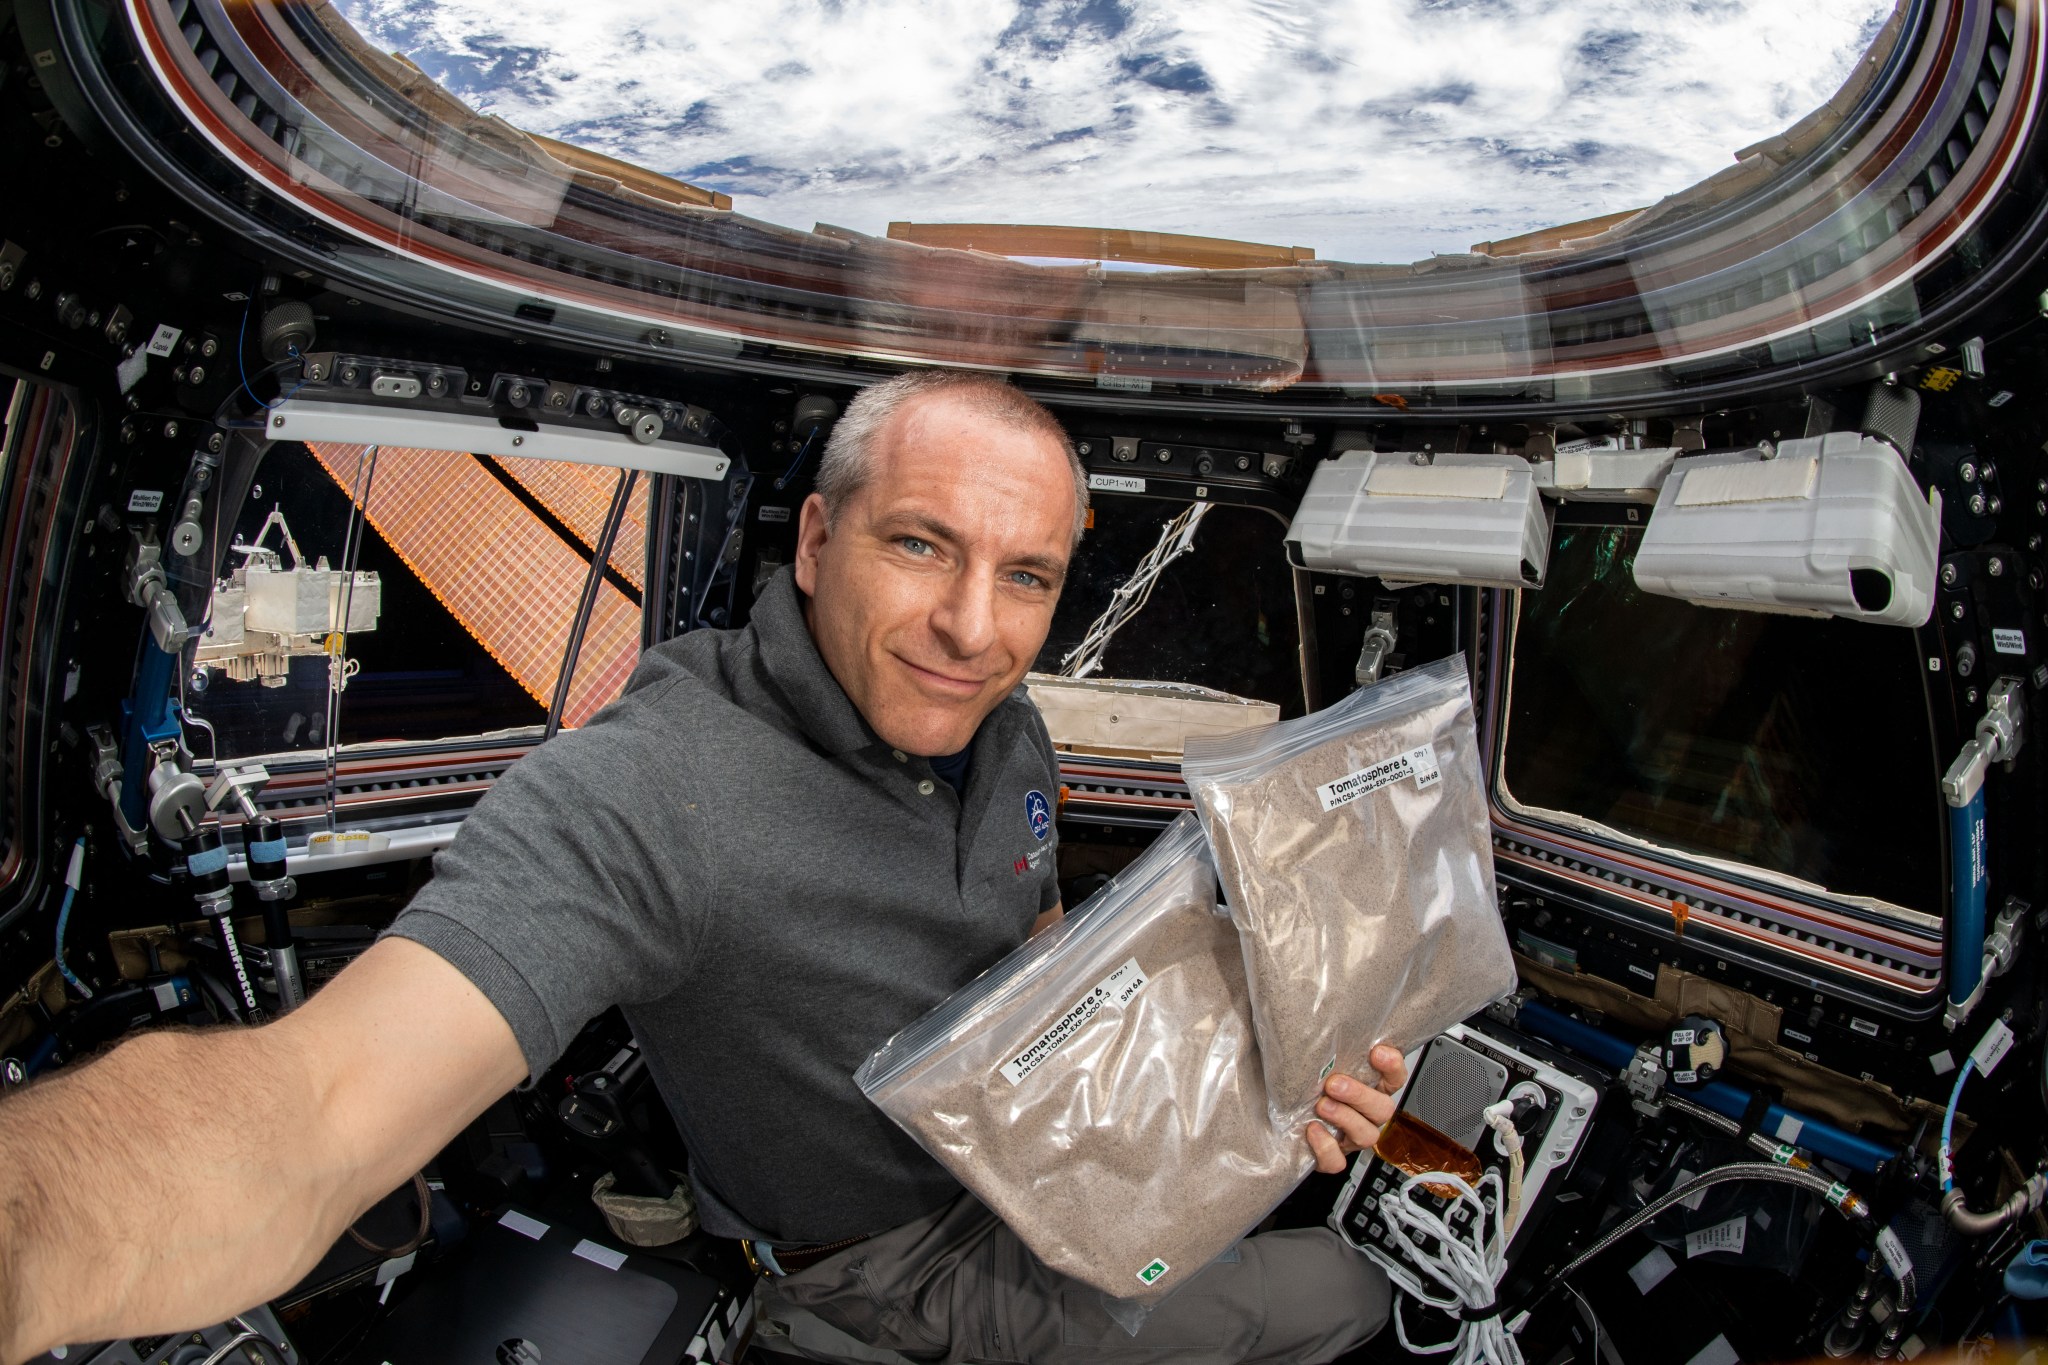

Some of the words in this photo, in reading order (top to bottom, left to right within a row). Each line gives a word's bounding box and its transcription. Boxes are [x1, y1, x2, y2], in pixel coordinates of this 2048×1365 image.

[1095, 477, 1138, 488] CUP1-W1
[1629, 511, 1636, 519] A
[1931, 660, 1937, 669] 3
[1413, 749, 1424, 759] Qty
[1328, 759, 1400, 796] Tomatosphere
[1401, 755, 1408, 767] 6
[1419, 774, 1430, 785] S/N
[1430, 771, 1438, 780] 6B
[1329, 796, 1342, 807] P/N
[314, 834, 333, 843] KEEP
[220, 916, 256, 1008] Manfrotto
[1110, 969, 1123, 981] Qty
[1121, 987, 1134, 1002] S/N
[1132, 978, 1143, 989] 6A
[1013, 995, 1095, 1068] Tomatosphere
[1095, 987, 1103, 996] 6
[1017, 1065, 1031, 1079] P/N
[1030, 991, 1111, 1067] CSA-TOMA-EXP-0001-3
[1466, 1039, 1484, 1052] AUDIO
[1486, 1048, 1515, 1068] TERMINAL
[1517, 1065, 1533, 1076] UNIT
